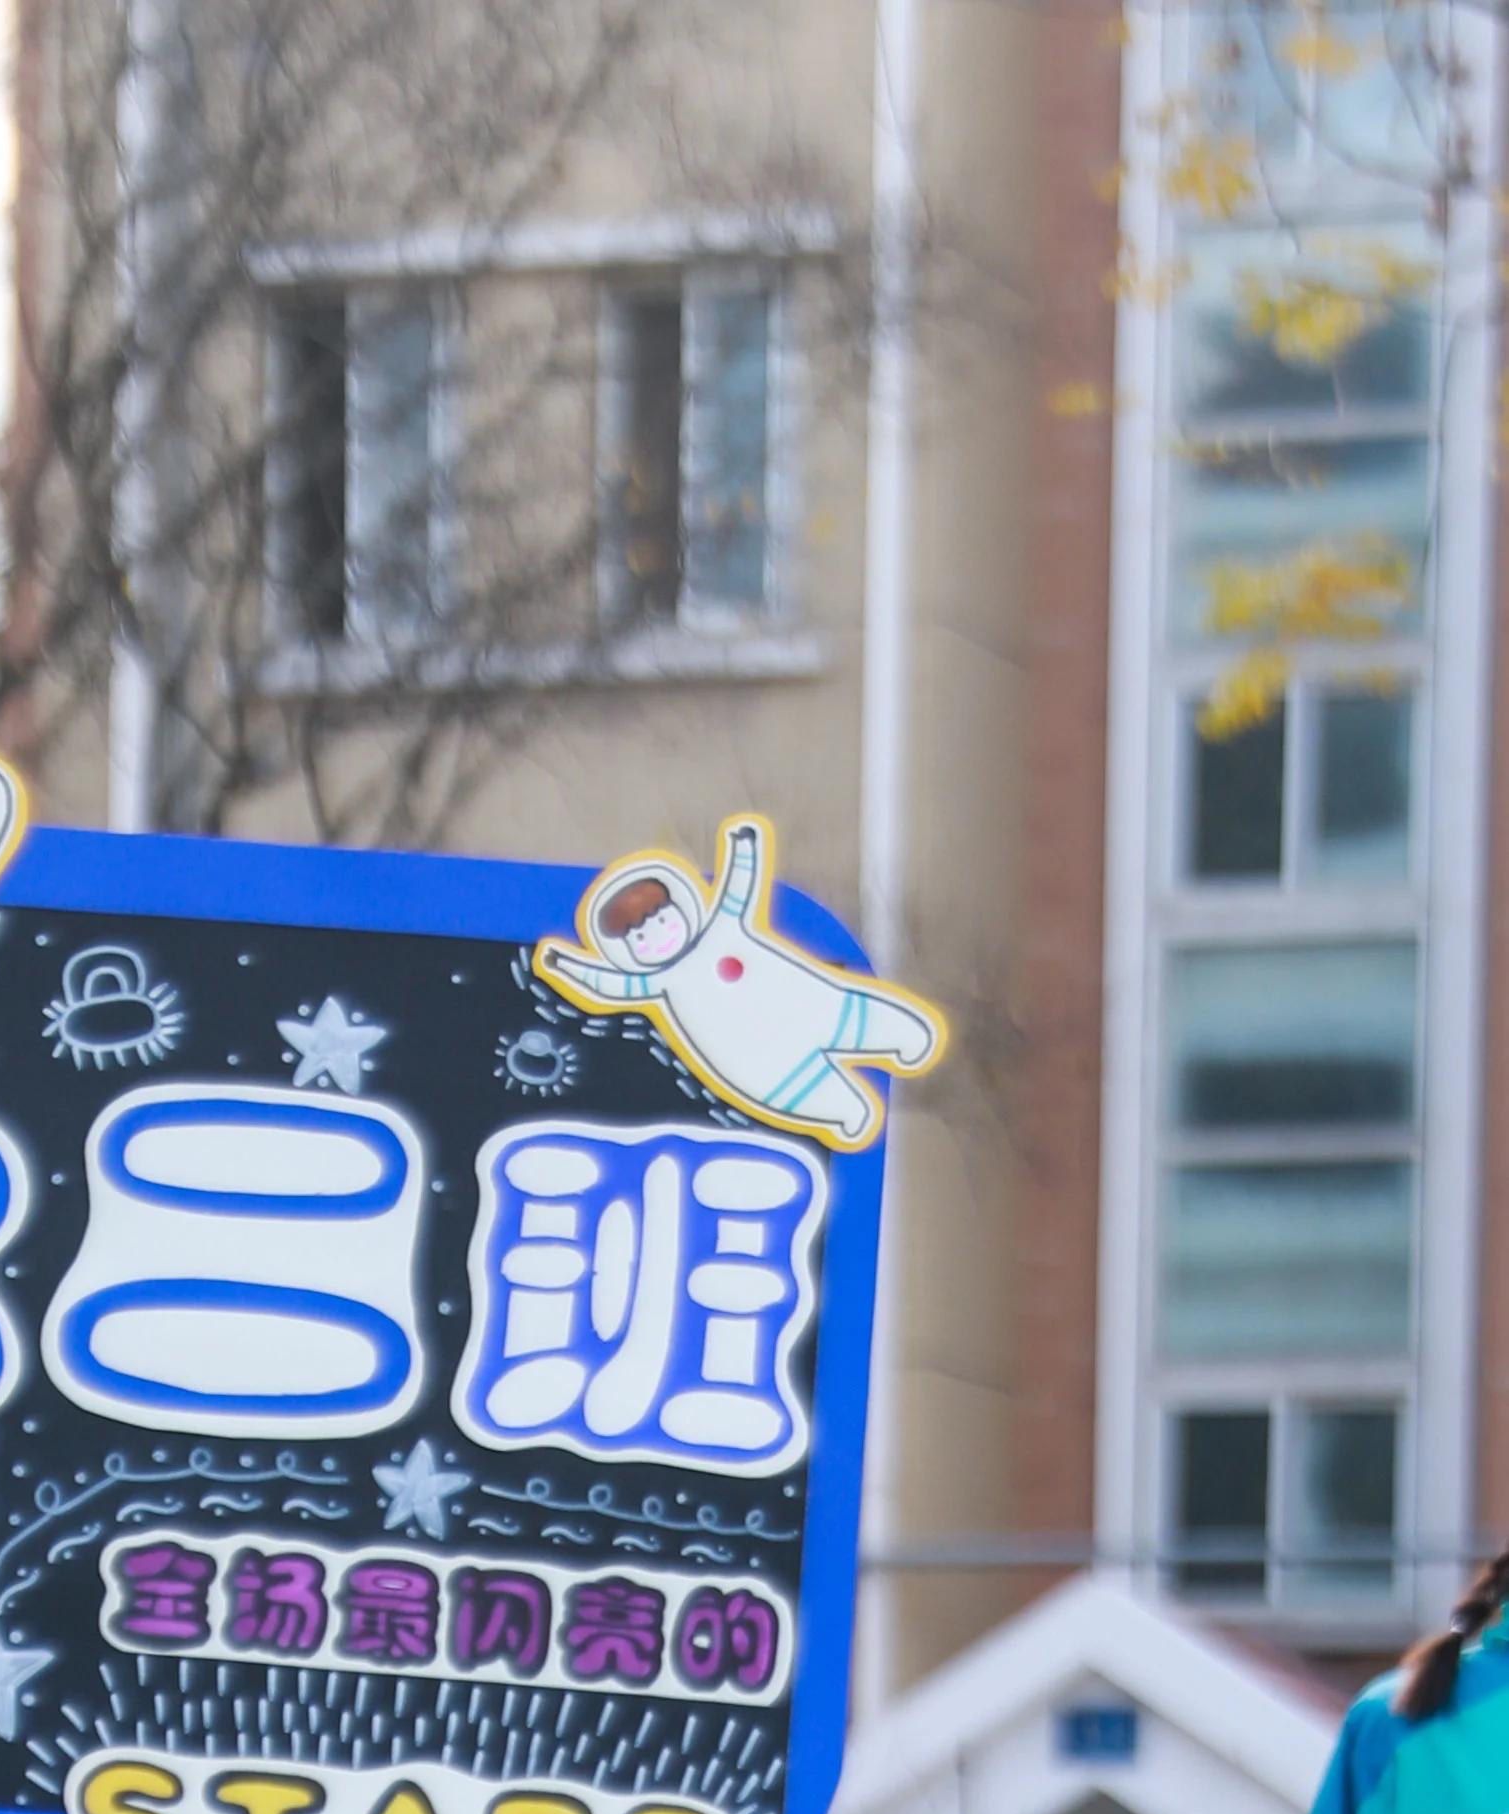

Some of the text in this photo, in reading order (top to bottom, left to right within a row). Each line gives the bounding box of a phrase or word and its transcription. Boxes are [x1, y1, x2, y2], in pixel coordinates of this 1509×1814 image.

[114, 1541, 779, 1691] 全场最闪亮的
